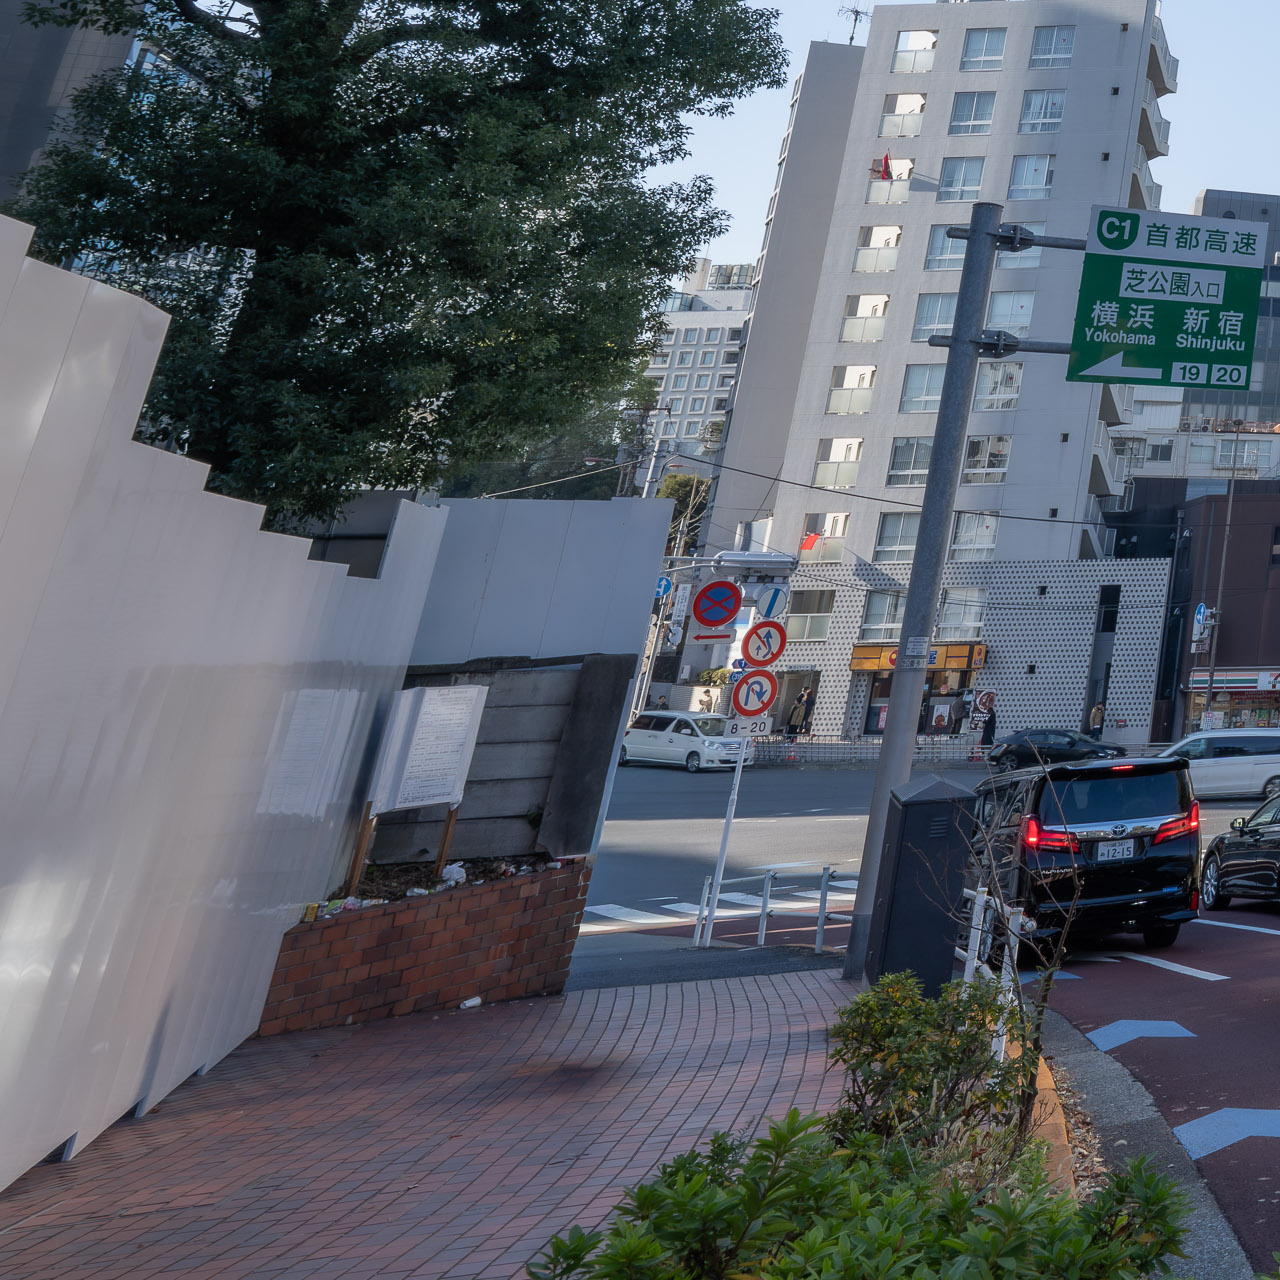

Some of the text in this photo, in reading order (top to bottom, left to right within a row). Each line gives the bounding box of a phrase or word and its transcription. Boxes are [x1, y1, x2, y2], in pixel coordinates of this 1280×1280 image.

[1101, 216, 1132, 240] C1
[1146, 223, 1258, 256] 首都高速
[1124, 268, 1220, 299] 芝公園入口
[1091, 300, 1244, 336] 横浜 新宿
[1084, 327, 1246, 352] Yokohama Shinjuku
[1179, 365, 1242, 383] 19 20
[1106, 846, 1132, 859] 12-15
